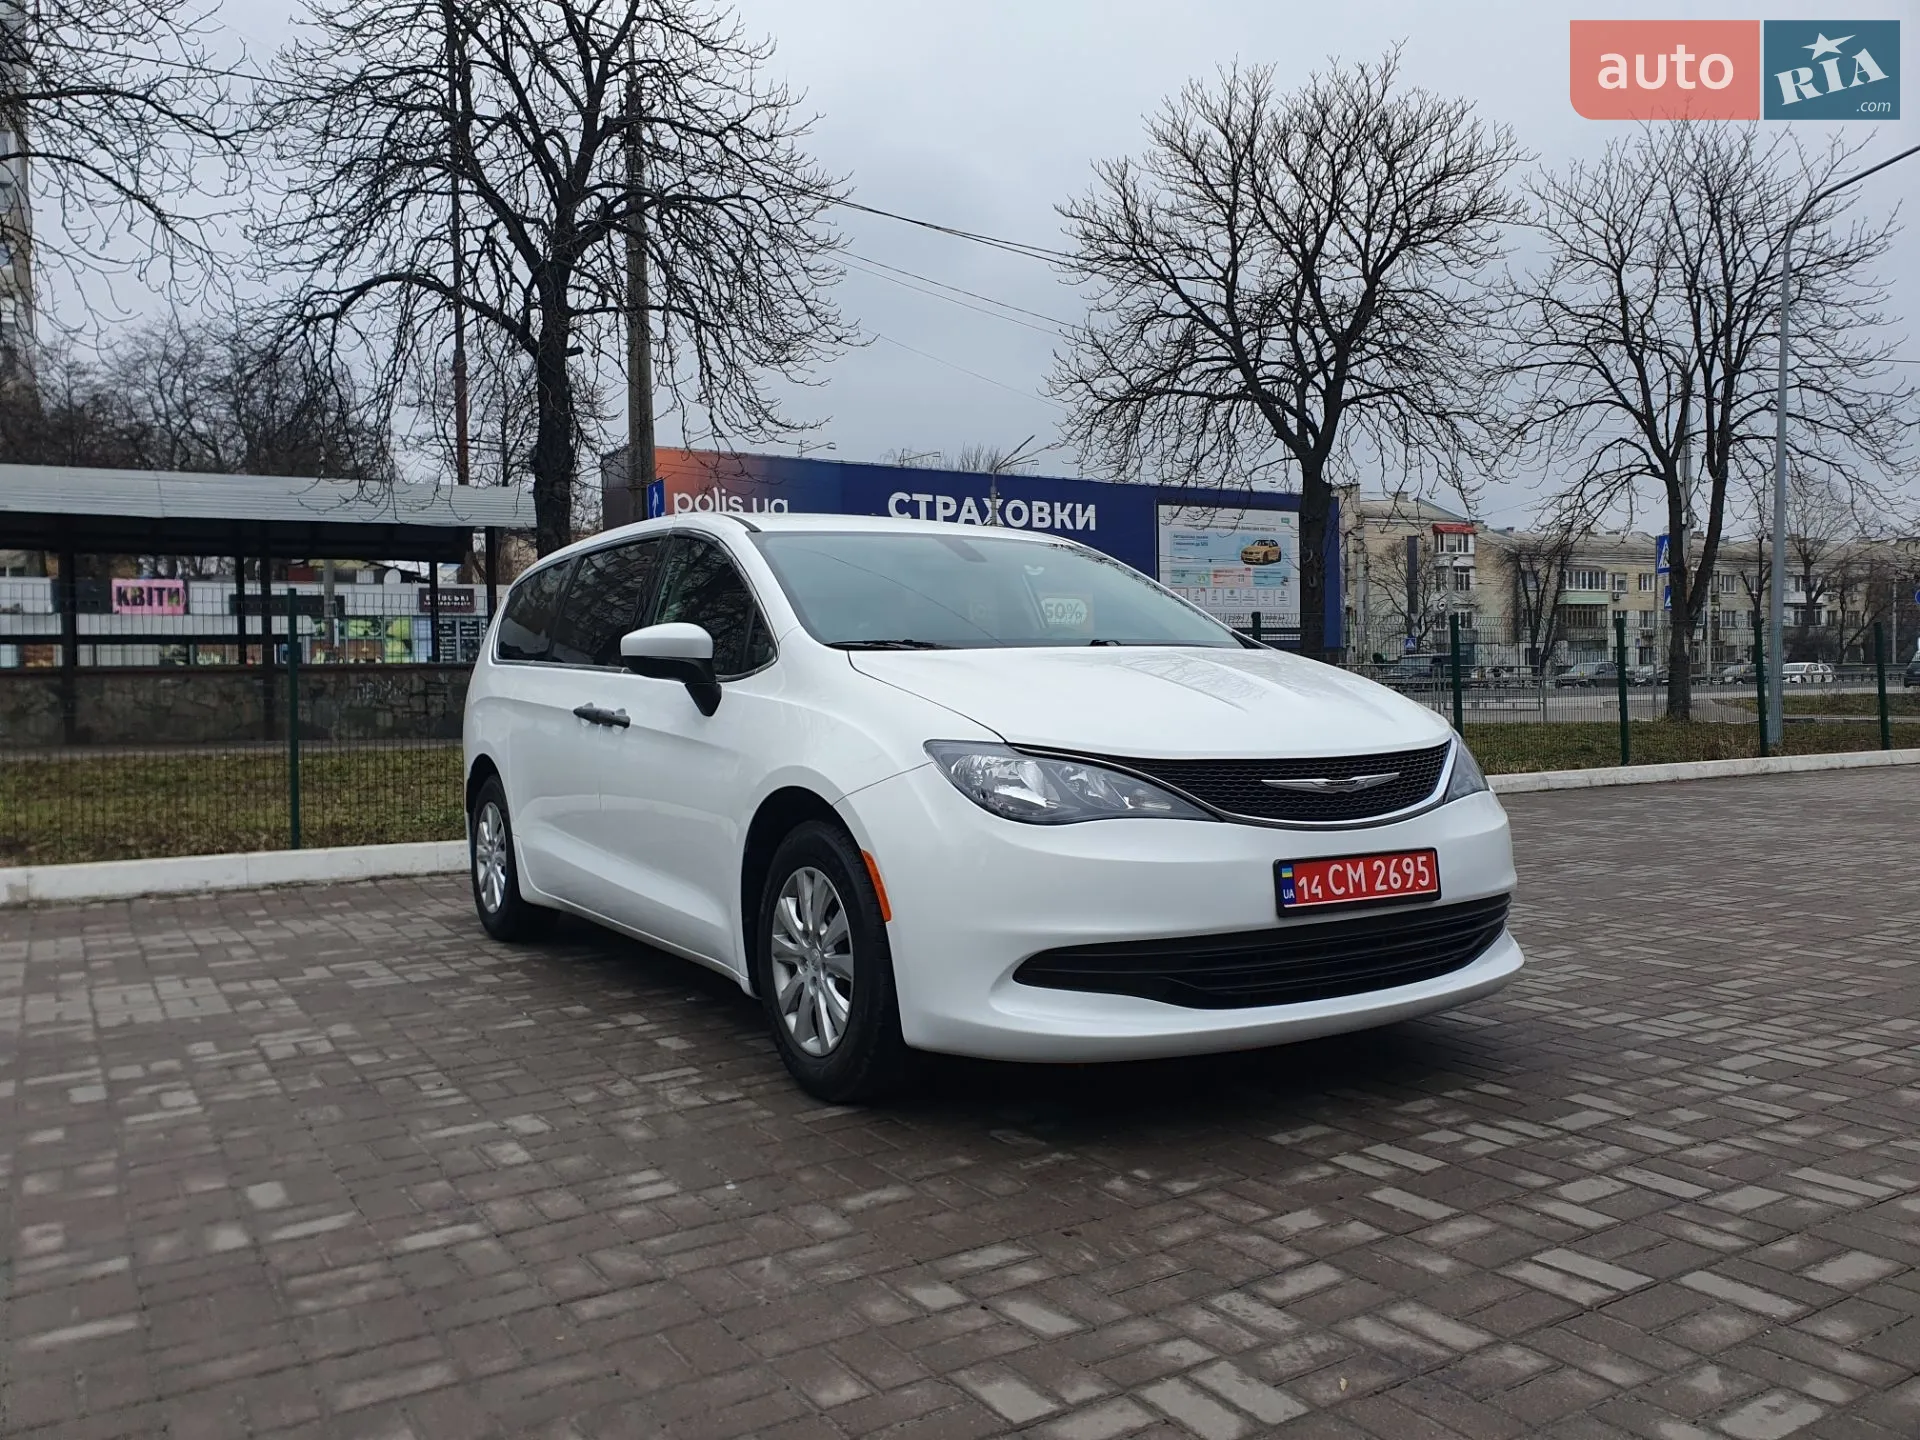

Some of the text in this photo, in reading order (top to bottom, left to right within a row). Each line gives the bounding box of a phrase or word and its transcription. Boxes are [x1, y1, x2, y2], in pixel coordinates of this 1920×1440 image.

[888, 492, 1096, 531] СТРАХОВКИ
[116, 586, 181, 607] КВІТИ
[1298, 855, 1430, 900] 14 CM 2695
[1283, 888, 1295, 900] UA
